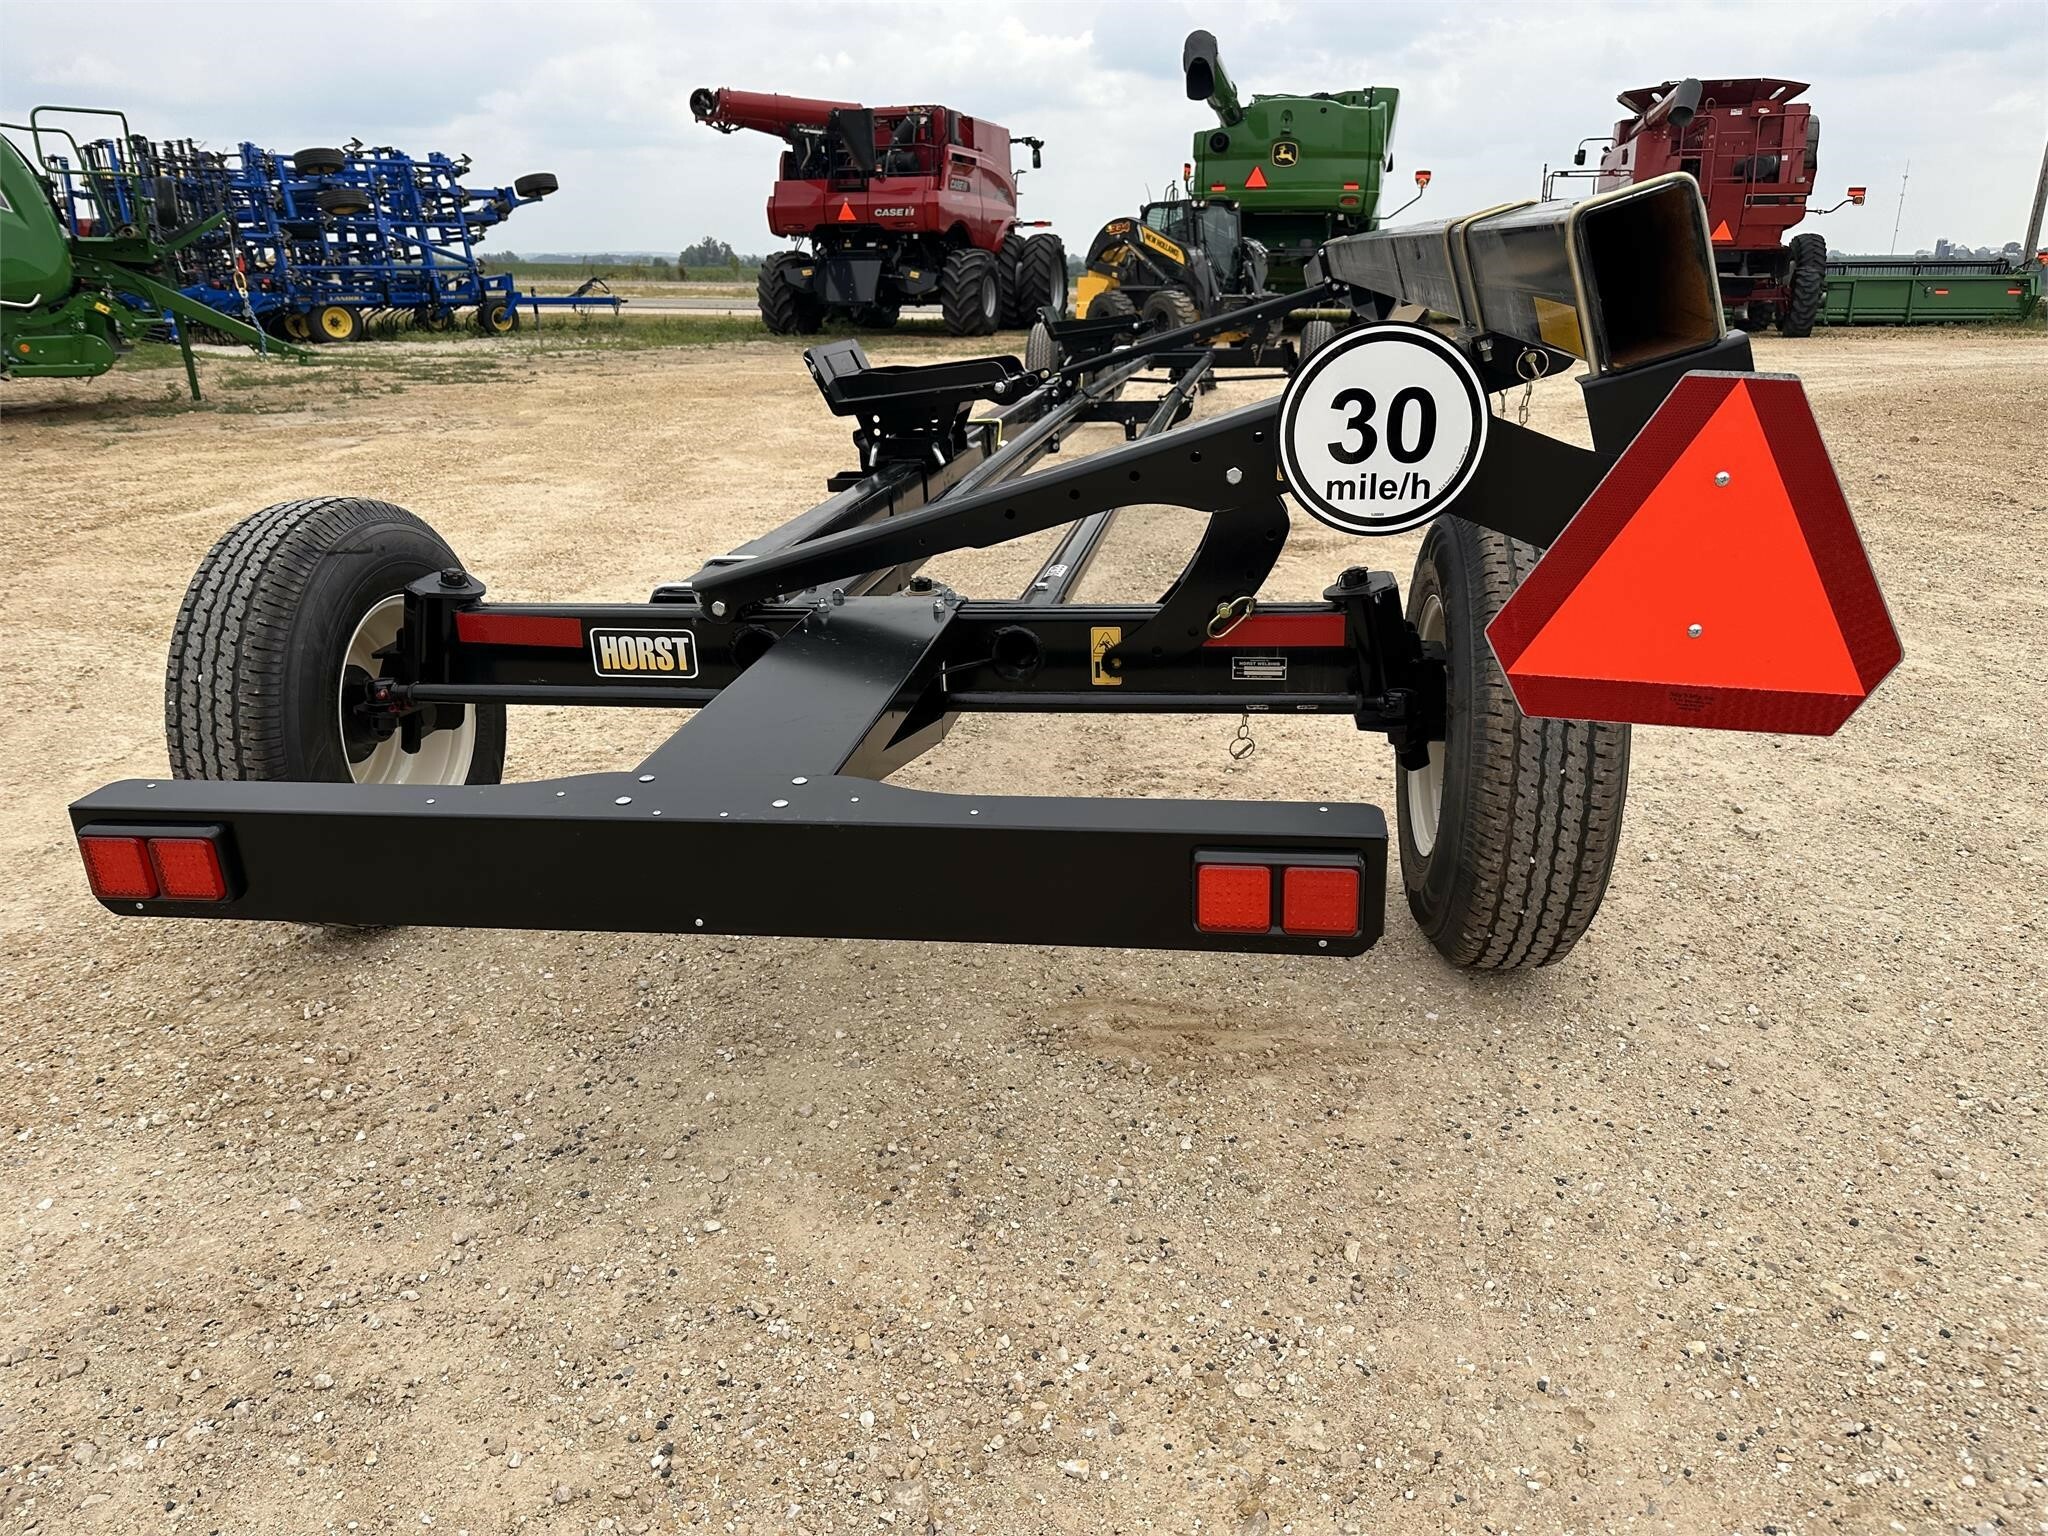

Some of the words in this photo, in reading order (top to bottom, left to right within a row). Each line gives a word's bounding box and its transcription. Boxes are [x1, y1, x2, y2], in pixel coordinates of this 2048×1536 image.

[874, 208, 904, 216] CASE
[1145, 232, 1156, 244] NEW
[1327, 386, 1437, 465] 30
[1326, 472, 1431, 501] mile/h
[599, 636, 690, 672] HORST
